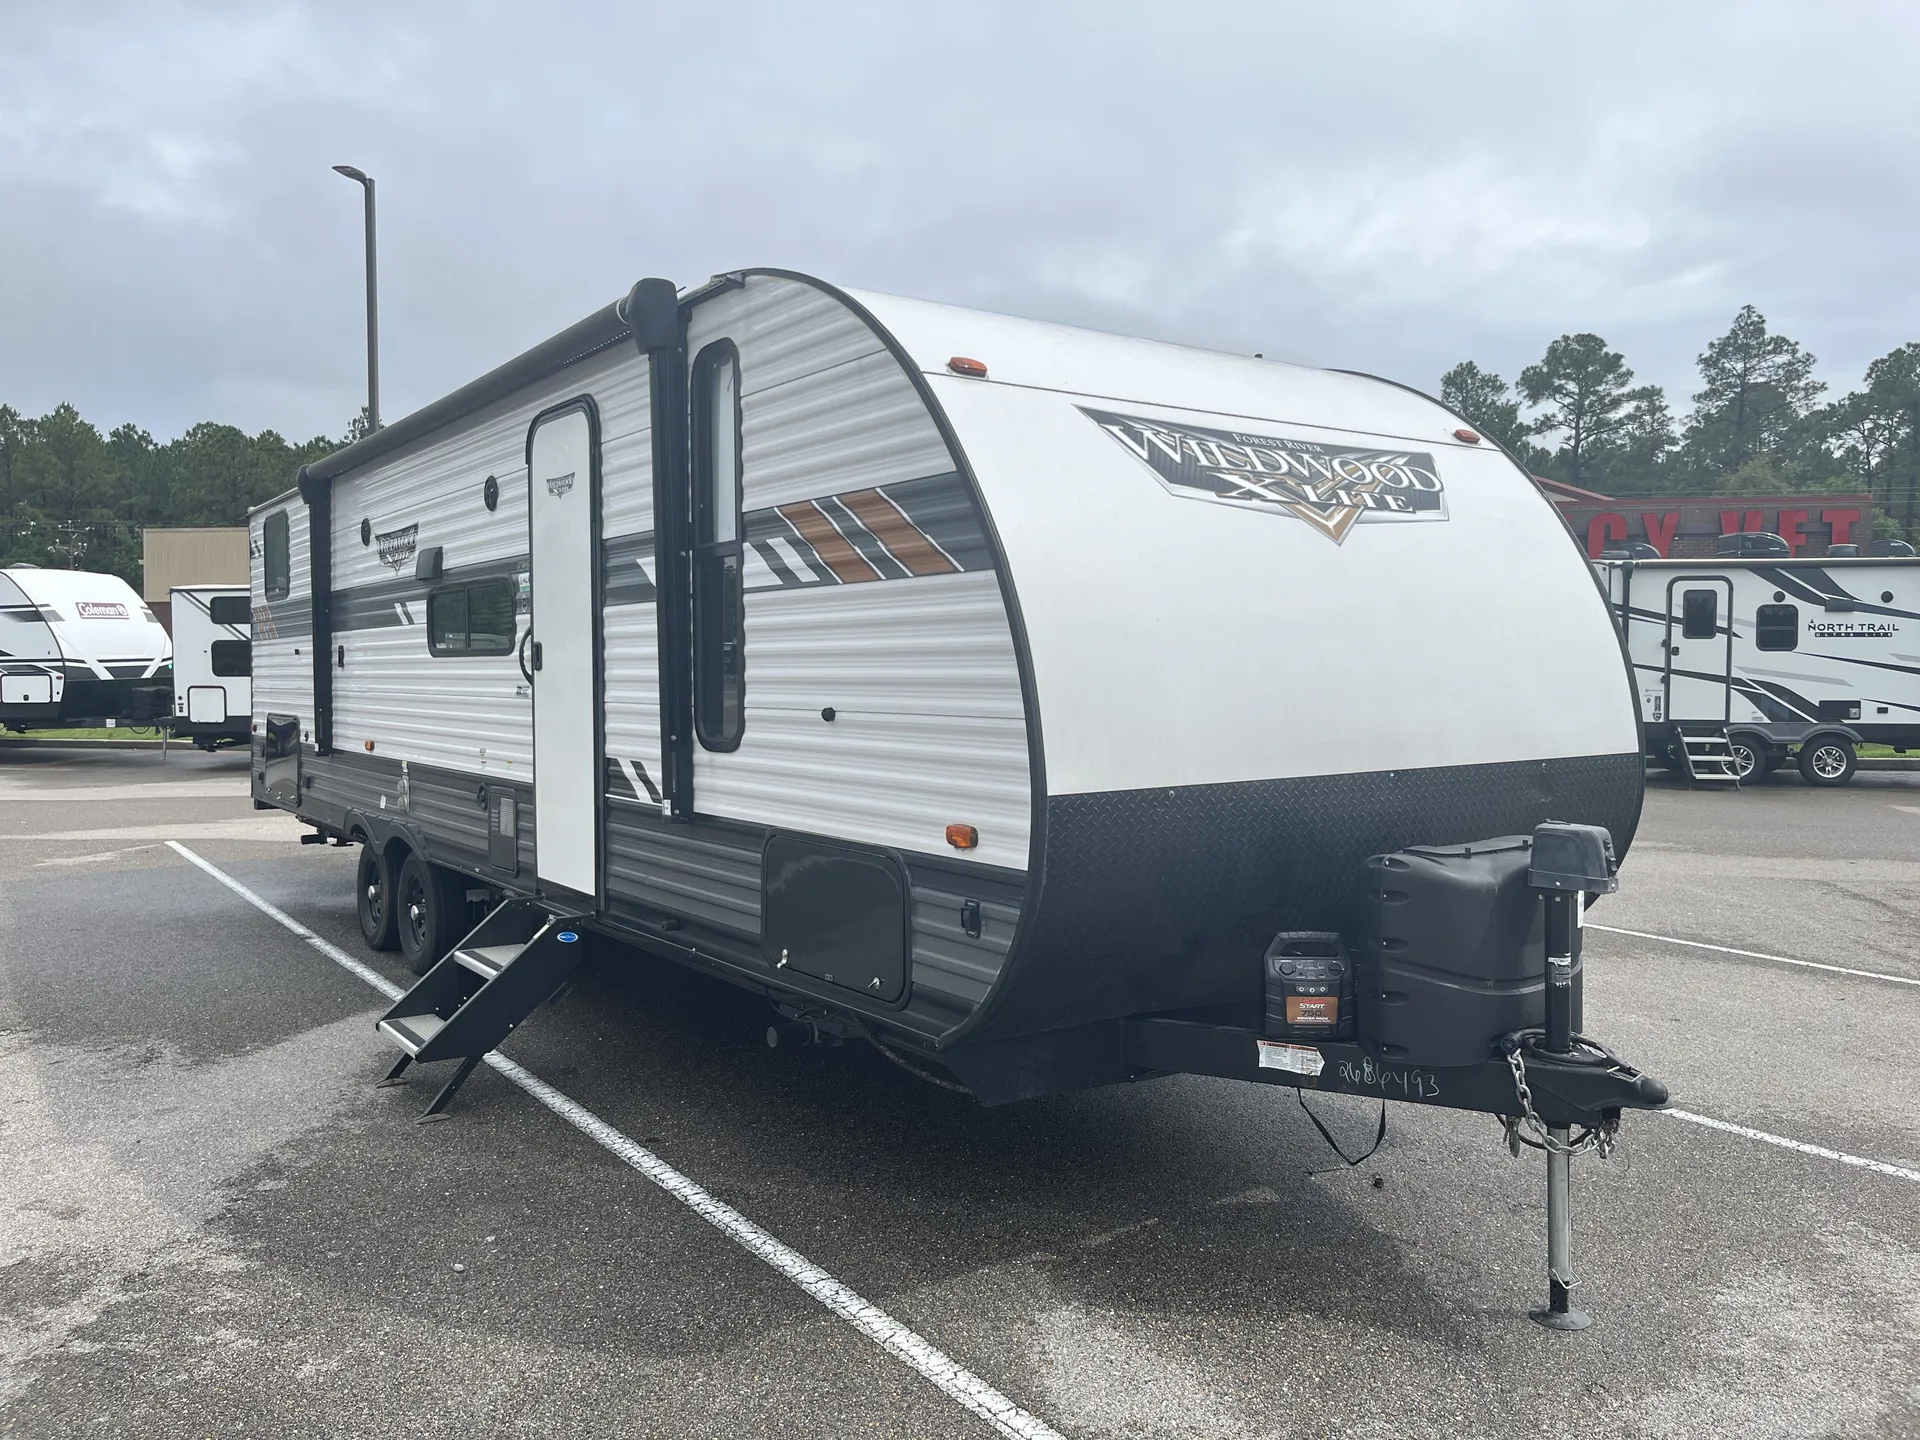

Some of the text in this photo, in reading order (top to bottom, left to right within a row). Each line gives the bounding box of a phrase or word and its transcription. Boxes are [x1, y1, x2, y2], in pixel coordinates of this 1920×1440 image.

[1232, 433, 1324, 453] FOREST RIVER
[1099, 423, 1444, 492] WILDWOOD
[1564, 511, 1680, 558] CY
[78, 603, 119, 616] Coleman
[1808, 623, 1899, 631] NORTH TRAIL
